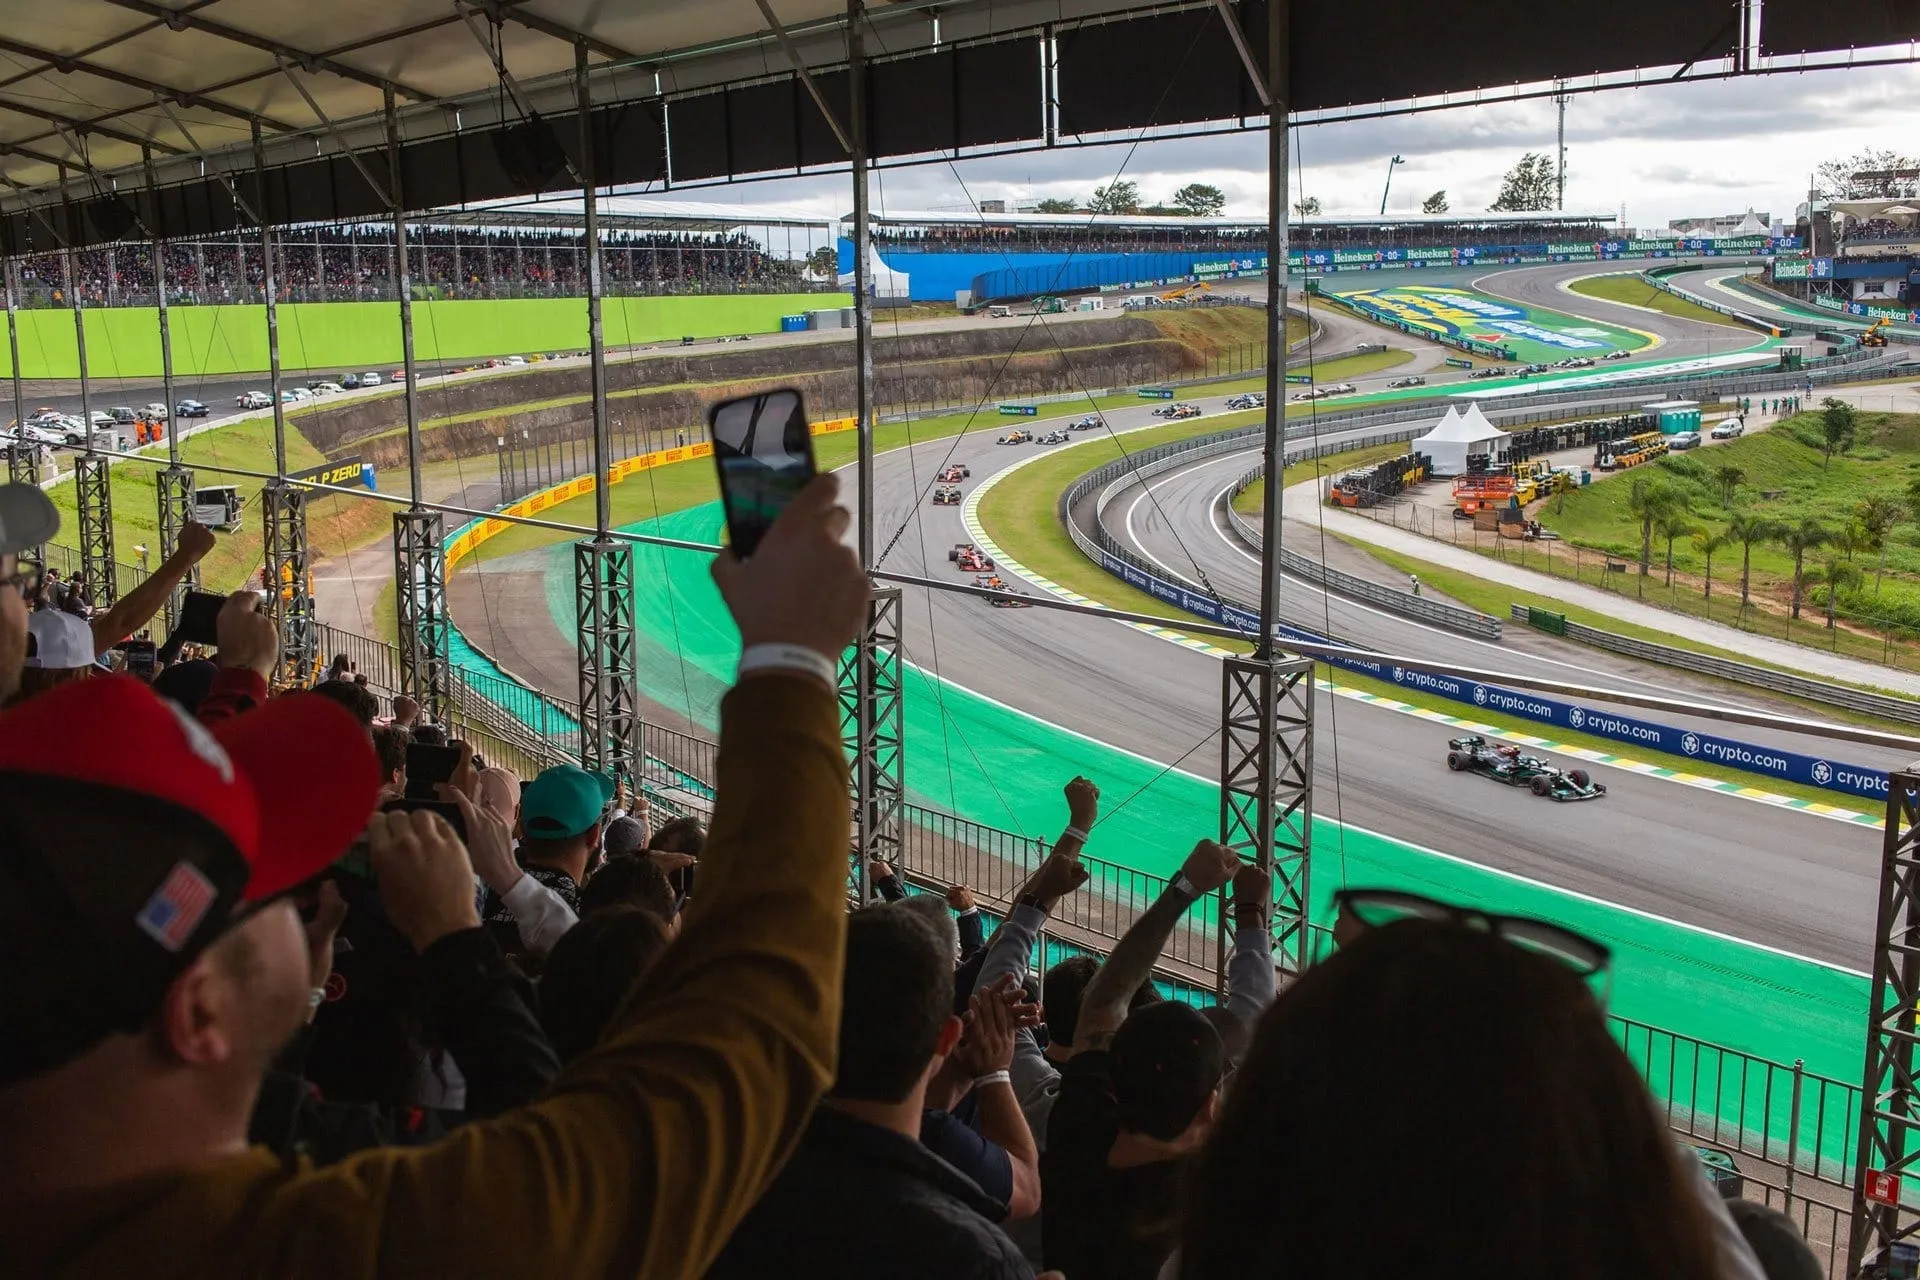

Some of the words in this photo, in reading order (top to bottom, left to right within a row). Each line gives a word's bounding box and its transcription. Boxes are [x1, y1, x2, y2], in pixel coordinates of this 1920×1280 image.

[1548, 244, 1590, 254] Heineken
[1629, 241, 1673, 251] Heineken
[1714, 239, 1761, 248] Heineken
[1334, 253, 1373, 263] Heineken
[1407, 249, 1449, 259] Heineken
[1194, 263, 1228, 273] Heineken
[1775, 260, 1806, 277] Heineken
[1816, 295, 1842, 310] Heineken
[1867, 307, 1907, 321] Heineken
[826, 421, 843, 432] PIRELLI
[322, 471, 330, 485] P
[331, 463, 361, 484] ZERO
[1155, 585, 1178, 601] crypto.com
[1189, 599, 1216, 616] crypto.com
[1407, 671, 1460, 694] crypto.com
[1490, 692, 1551, 718] crypto.com
[1588, 715, 1661, 743] crypto.com
[1703, 742, 1787, 771] crypto.com
